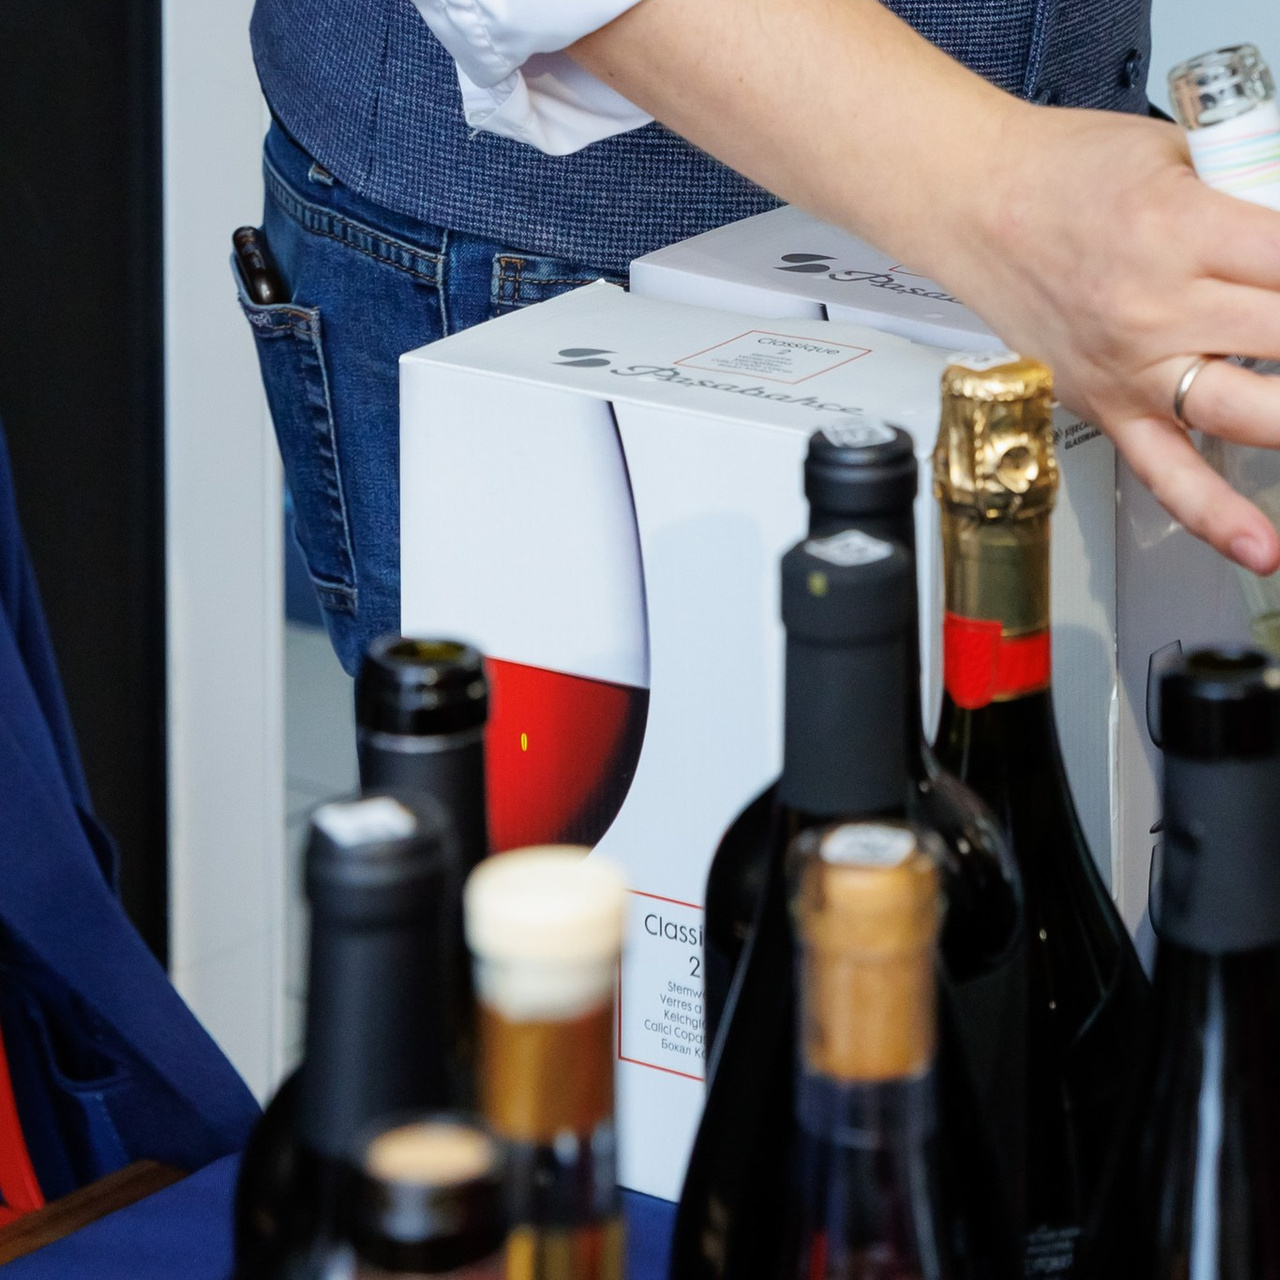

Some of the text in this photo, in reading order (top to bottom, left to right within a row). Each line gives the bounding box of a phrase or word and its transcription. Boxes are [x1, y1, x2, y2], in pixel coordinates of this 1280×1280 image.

[757, 337, 840, 356] Classique
[644, 914, 704, 947] Classi
[689, 956, 701, 978] 2
[659, 993, 692, 1012] Verres
[644, 1019, 705, 1045] Calici Copa
[661, 1038, 691, 1056] Бокал
